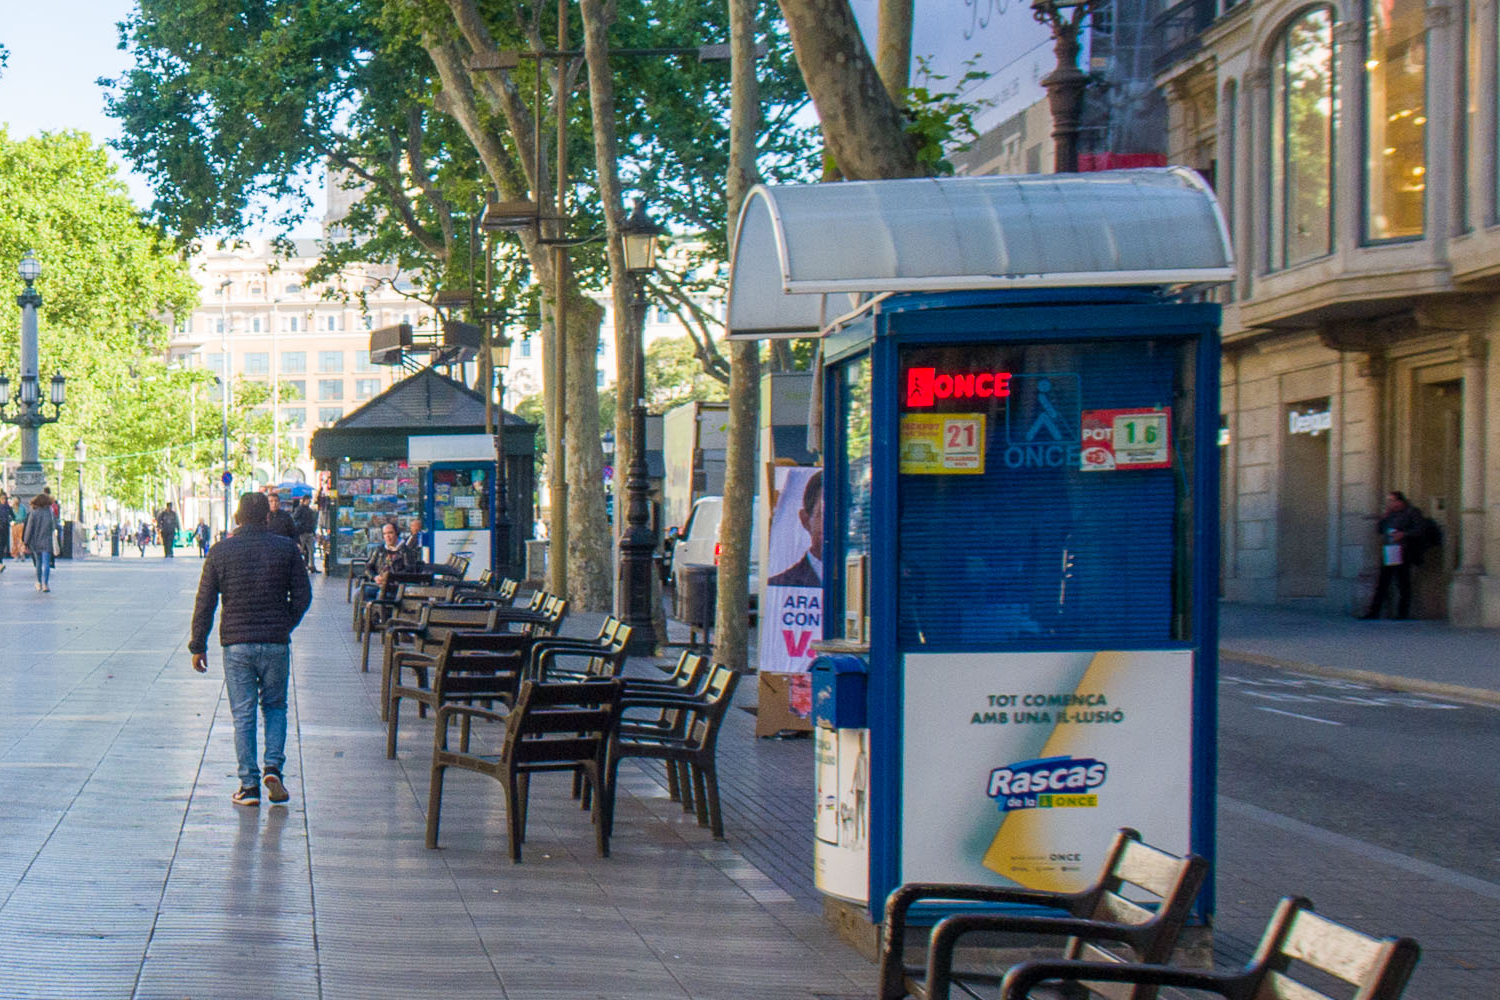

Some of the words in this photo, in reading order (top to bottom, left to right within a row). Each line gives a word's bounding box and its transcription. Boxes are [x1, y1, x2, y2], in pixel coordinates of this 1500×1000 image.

[933, 371, 1012, 399] ONCE
[946, 424, 975, 449] 21
[1082, 428, 1113, 441] POT
[1003, 445, 1081, 468] ONCE
[783, 595, 820, 609] ARA
[782, 611, 822, 627] CON
[987, 694, 1019, 707] TOT
[970, 711, 1009, 724] AMB
[1013, 711, 1052, 724] UNA
[988, 762, 1106, 798] Rascas
[1006, 796, 1023, 808] de
[1025, 796, 1037, 807] la
[1055, 795, 1098, 807] ONCE
[1049, 852, 1082, 862] ONCE
